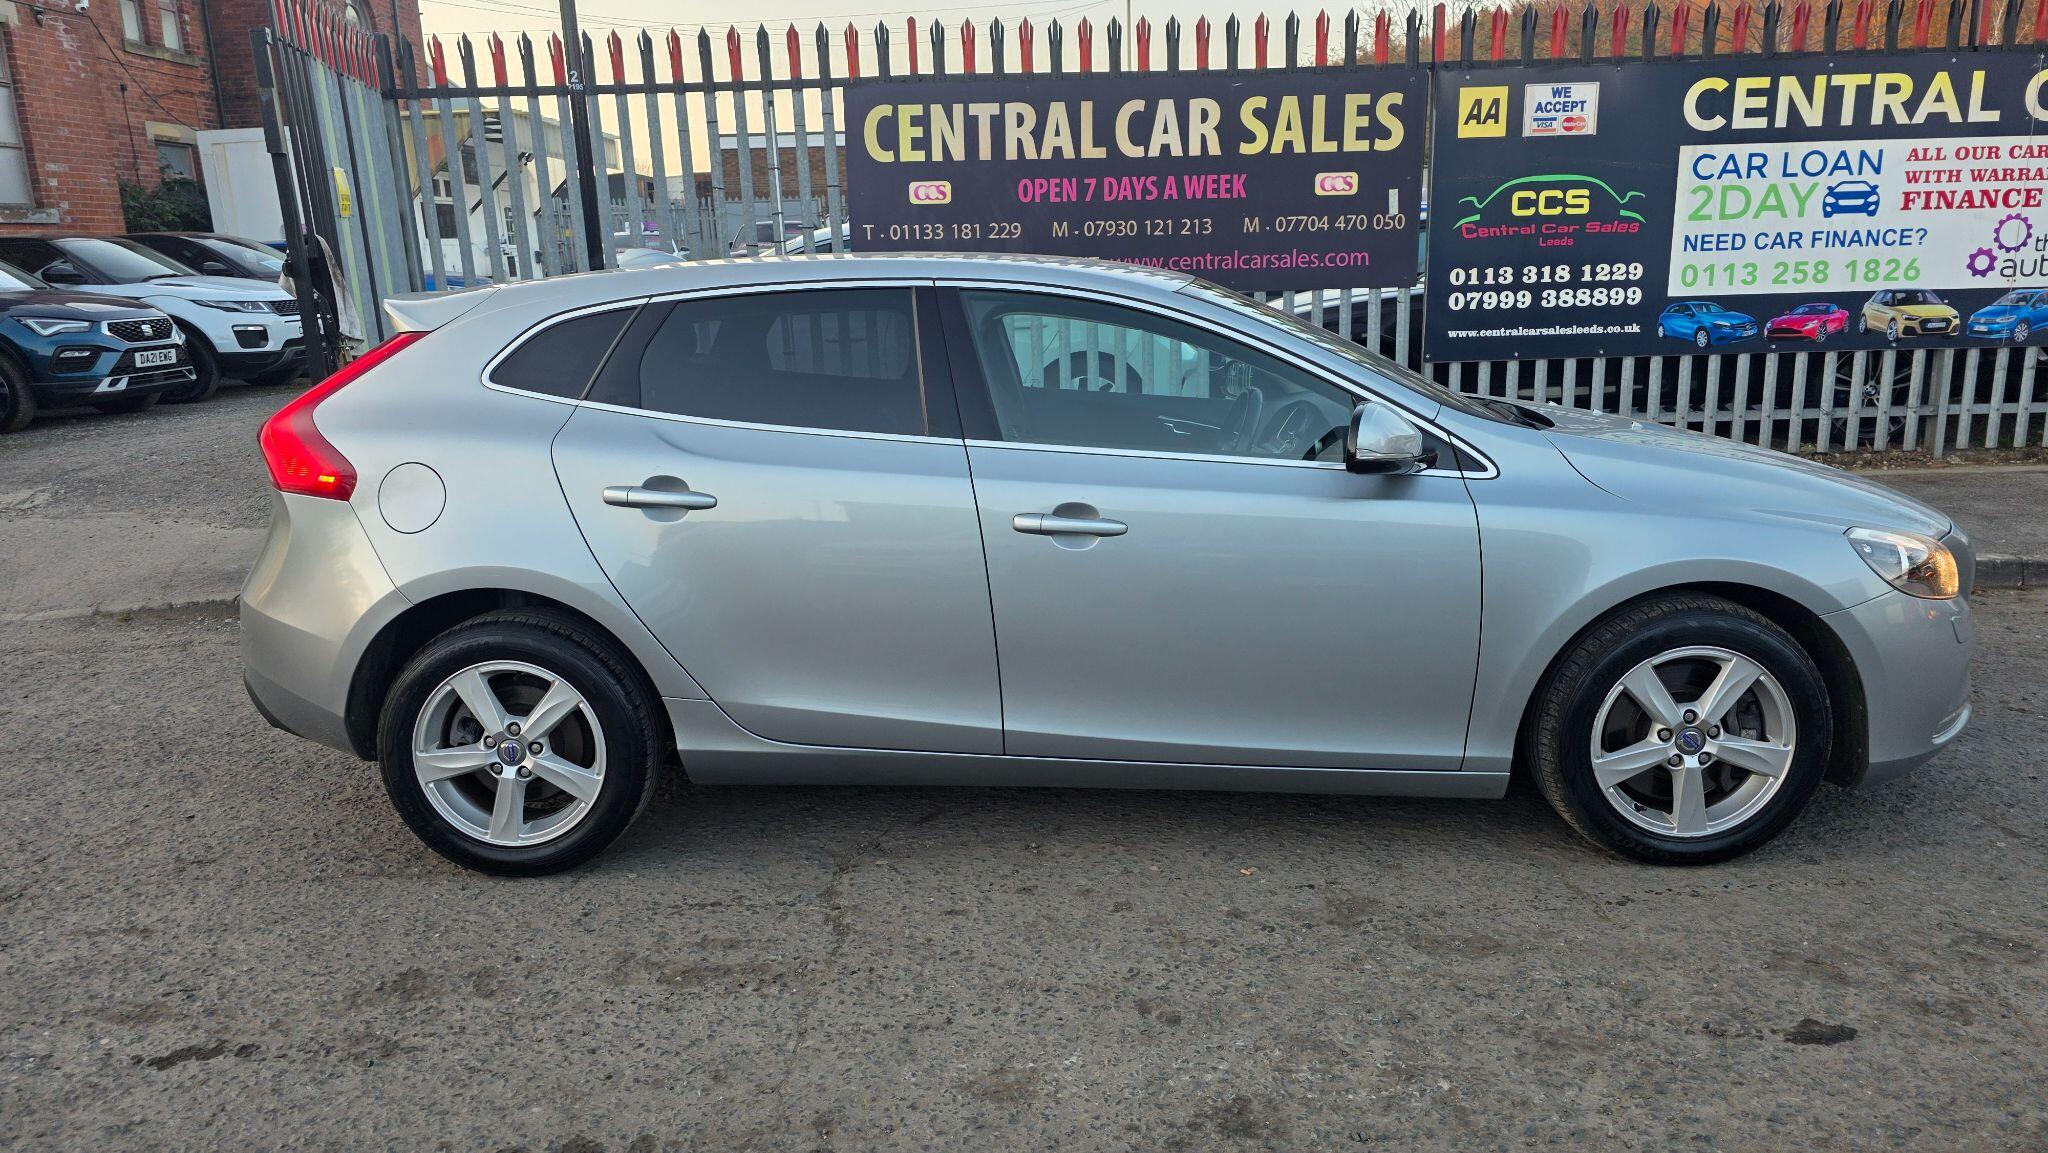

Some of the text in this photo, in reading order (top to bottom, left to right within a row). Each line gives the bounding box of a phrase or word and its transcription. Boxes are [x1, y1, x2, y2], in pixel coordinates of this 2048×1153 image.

[570, 70, 578, 83] 2
[1551, 86, 1572, 98] WE
[1683, 70, 2000, 132] CENTRAL
[1463, 98, 1500, 125] AA
[1534, 100, 1587, 113] ACCEPT
[863, 92, 1404, 162] CENTRAL CAR SALES
[1906, 147, 1947, 161] ALL
[1954, 145, 2001, 160] OUR
[1692, 149, 1883, 180] CAR LOAN
[1320, 176, 1353, 192] CCS
[1905, 167, 2048, 184] WITH WARRA
[914, 184, 947, 201] CCS
[1018, 174, 1248, 203] OPEN 7 DAYS A WEEK
[1512, 189, 1590, 217] CCS
[1687, 182, 1819, 221] 2DAY
[1900, 188, 2043, 211] FINANCE
[890, 224, 944, 240] 01133
[952, 224, 980, 239] 181
[988, 223, 1022, 239] 229
[1084, 220, 1137, 237] 07930
[1145, 219, 1172, 235] 121
[1180, 218, 1212, 235] 213
[1276, 216, 1329, 232] 07704
[1335, 214, 1367, 231] 470
[1373, 213, 1405, 230] 050
[1461, 220, 1640, 239] Central Car Sales
[1539, 236, 1574, 247] Leeds
[1683, 228, 1928, 252] NEED CAR FINANCE?
[1450, 262, 1644, 286] 0113 318 1229
[1680, 257, 1921, 287] 0113 258 1826
[1448, 286, 1643, 311] 07999 388899
[1448, 323, 1641, 338] www.centralcarsalesleeds.co.uk
[140, 353, 157, 365] DA21
